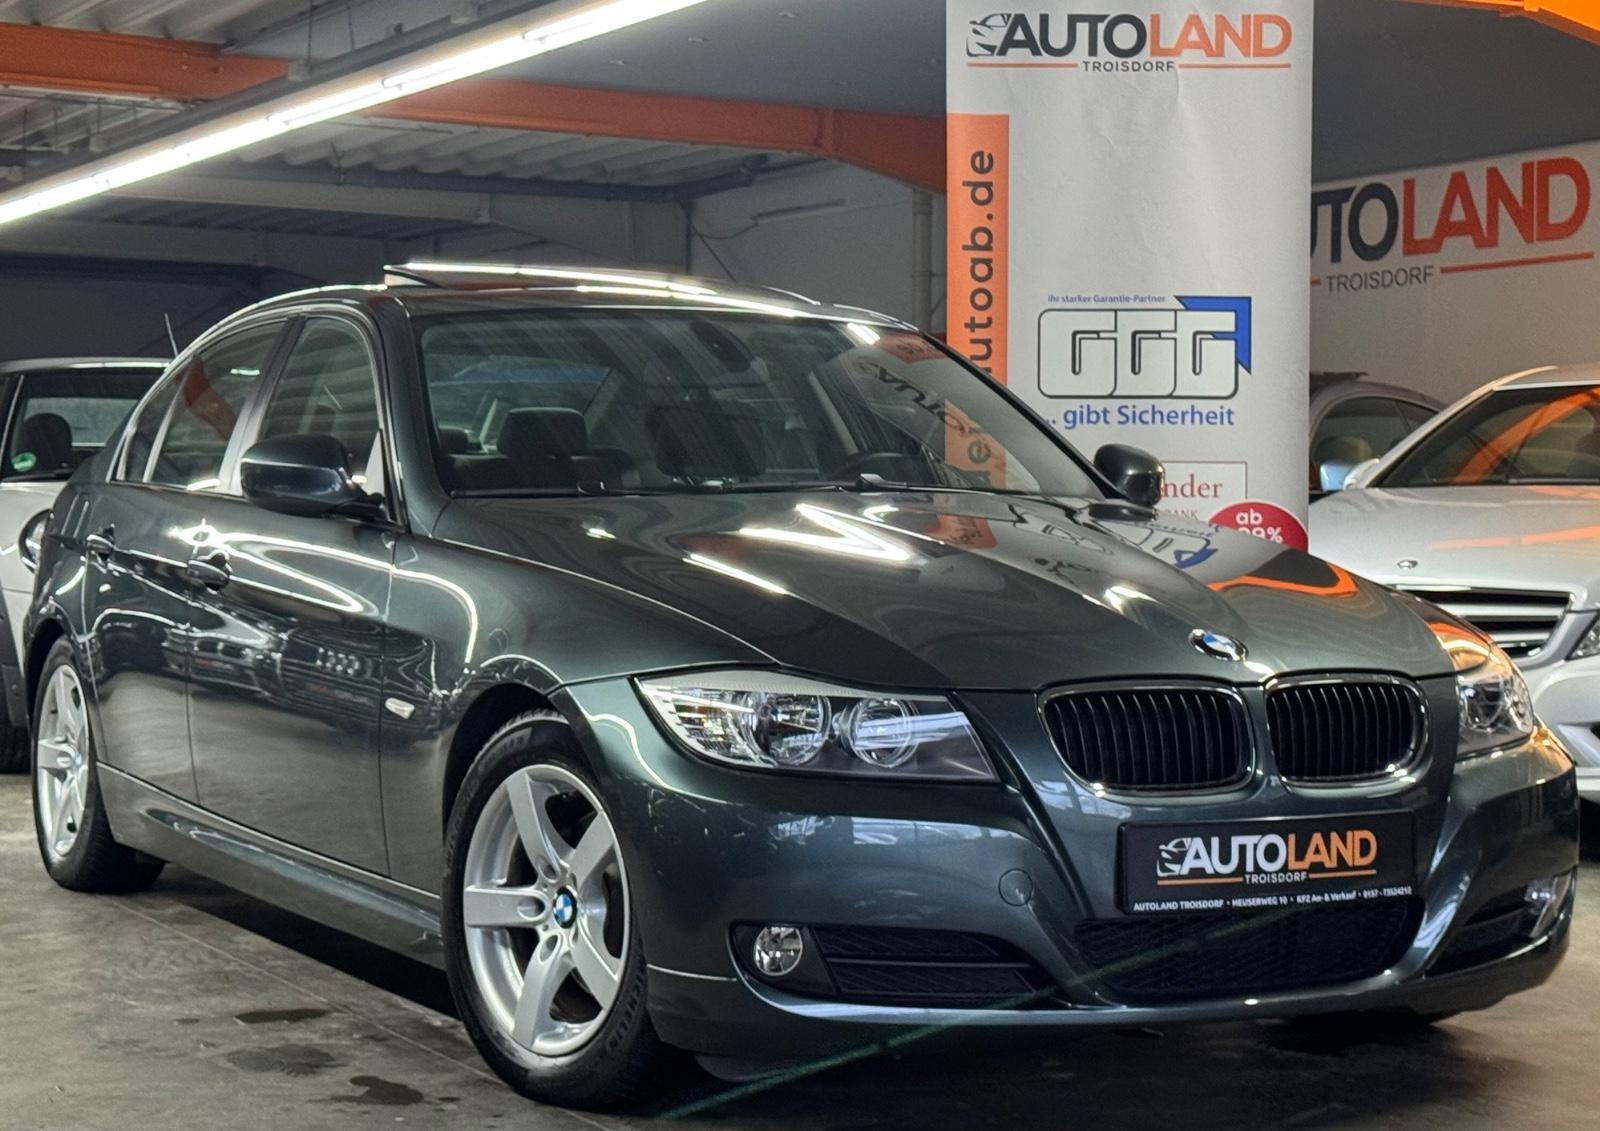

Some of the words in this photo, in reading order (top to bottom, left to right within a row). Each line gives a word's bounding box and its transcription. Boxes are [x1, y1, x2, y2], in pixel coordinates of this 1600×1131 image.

[996, 13, 1293, 58] AUTOLAND
[1083, 60, 1175, 72] TROISDORF
[1326, 265, 1434, 293] TROISDORF
[1048, 295, 1059, 303] Ihr
[1062, 295, 1091, 303] starker
[1093, 294, 1166, 303] Garantie-Partner
[1063, 405, 1110, 429] gibt
[1117, 404, 1235, 425] Sicherheit
[1162, 473, 1223, 498] nder
[1236, 508, 1263, 525] ab
[1179, 829, 1378, 876] AUTOLAND
[1244, 871, 1307, 884] TROISDORF
[1133, 901, 1178, 911] AUTOLAND
[1180, 899, 1224, 909] TROISDORF
